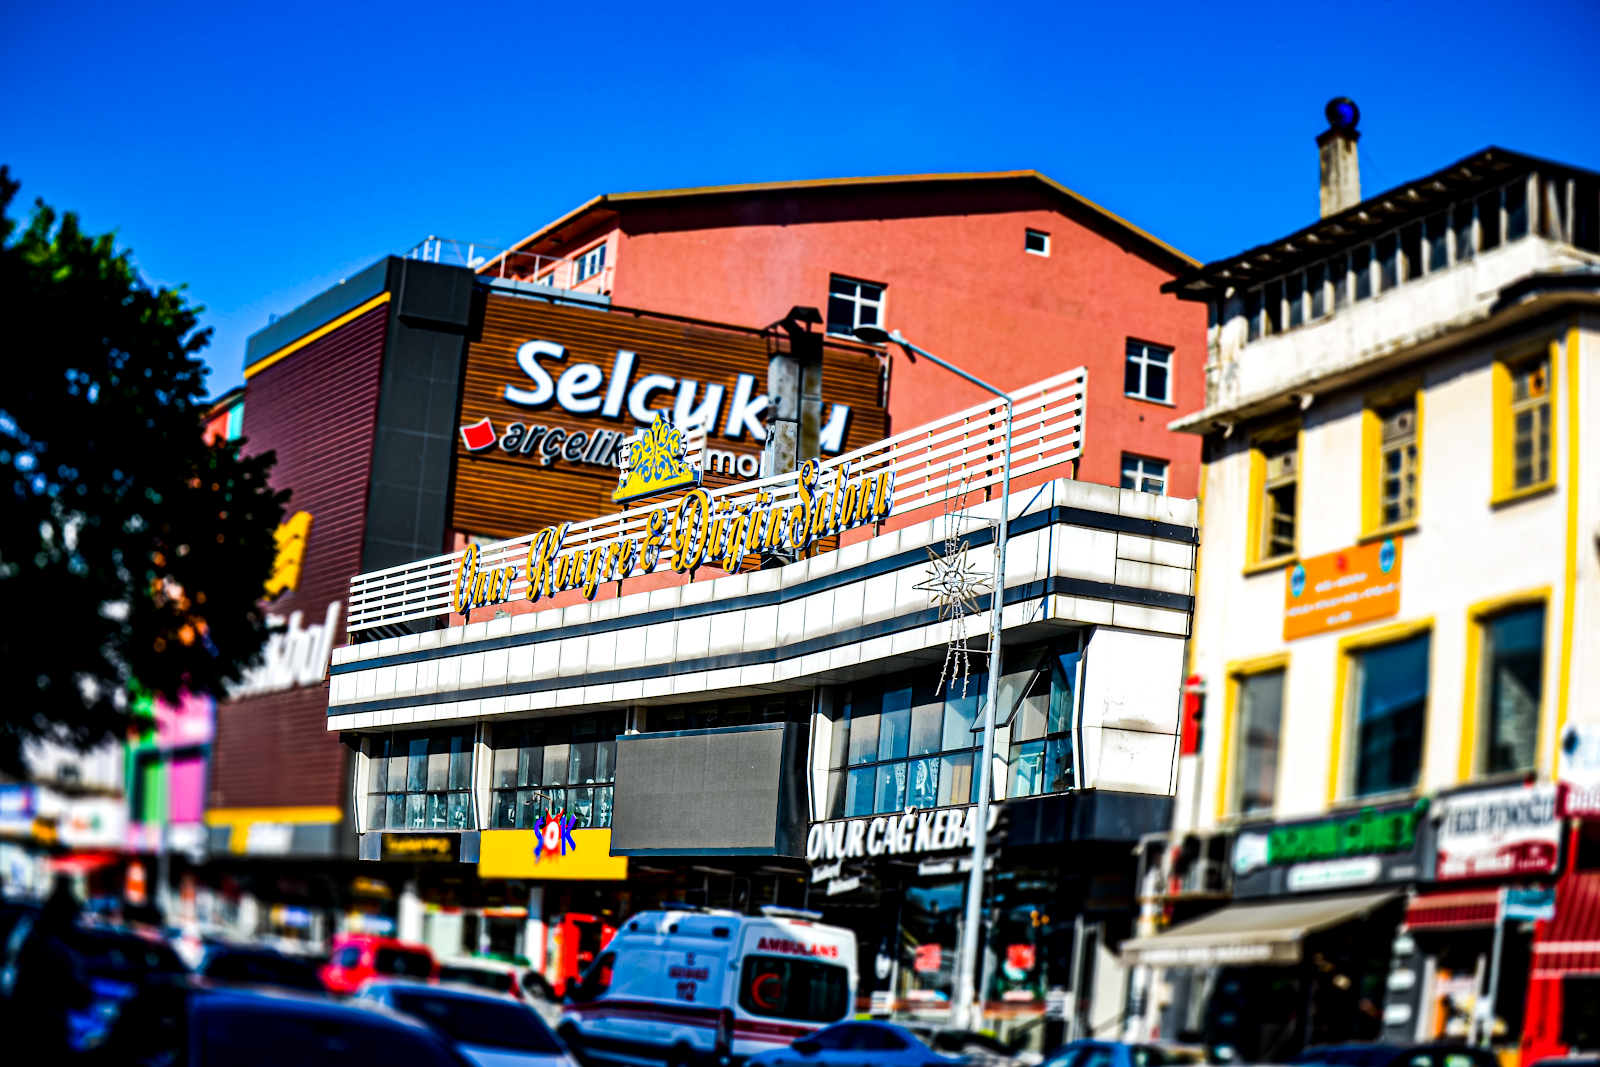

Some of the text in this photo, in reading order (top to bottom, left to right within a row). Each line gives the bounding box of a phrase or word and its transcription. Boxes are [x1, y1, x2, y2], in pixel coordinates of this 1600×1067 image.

[499, 421, 625, 468] arçelik
[454, 542, 519, 615] Onur
[526, 522, 638, 602] Kongre
[671, 488, 789, 574] Düğün
[789, 458, 896, 550] Salonu
[806, 821, 866, 861] ONUR
[757, 937, 839, 958] AMBULANS
